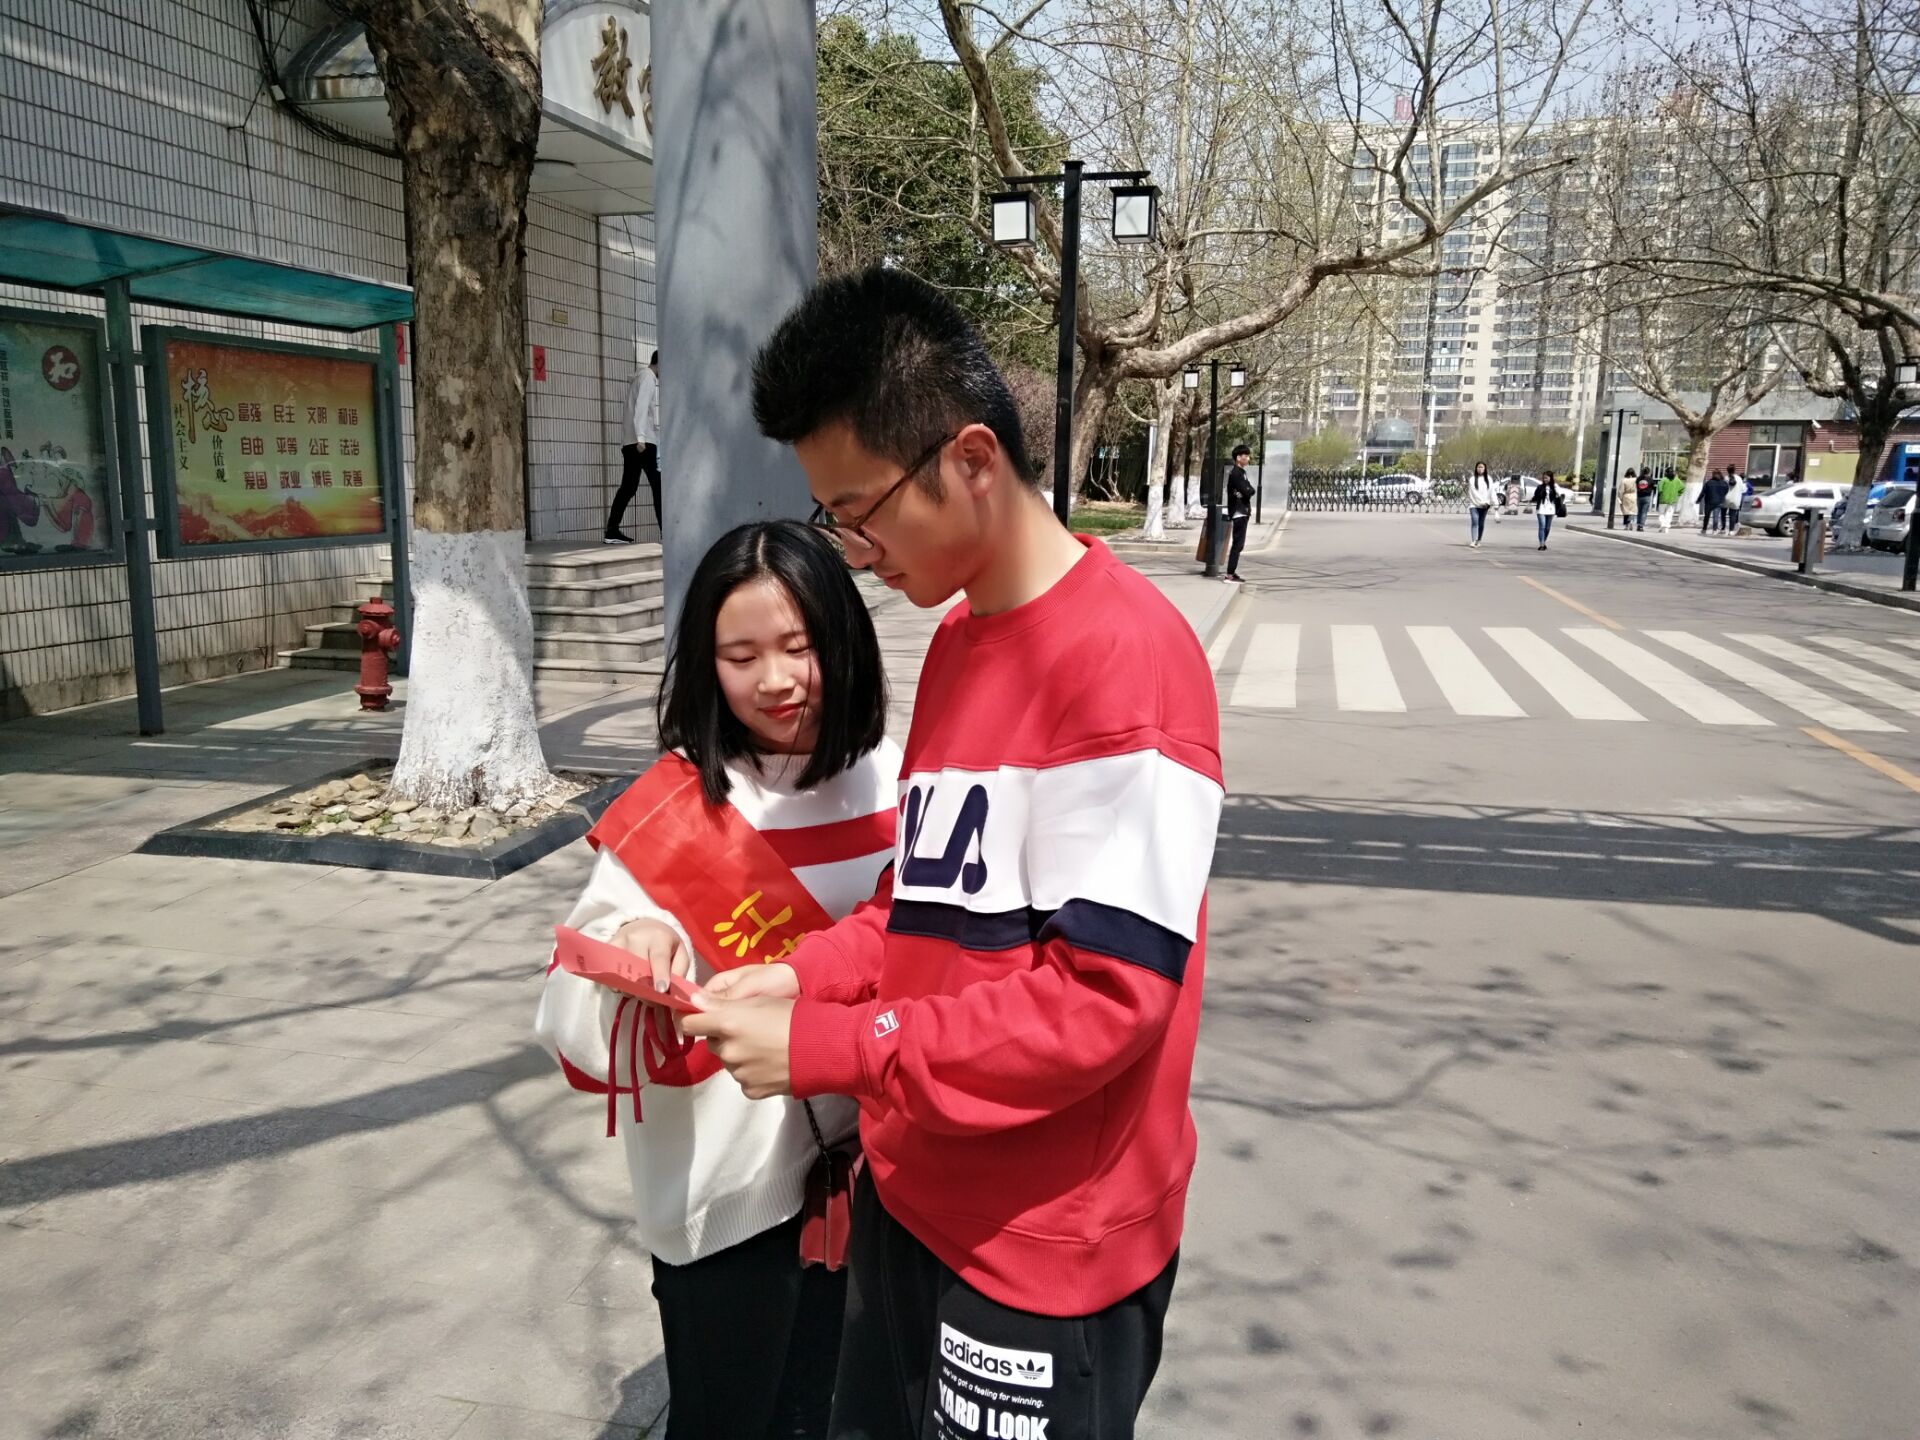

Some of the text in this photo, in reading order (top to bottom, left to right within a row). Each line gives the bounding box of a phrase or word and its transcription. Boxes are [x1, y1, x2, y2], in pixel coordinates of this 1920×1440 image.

[238, 403, 359, 425] 富强 民主 文明 和谐
[174, 403, 189, 470] 社会主义
[240, 436, 360, 456] 自由 平等 公正 法治
[212, 434, 227, 482] 价值观
[243, 470, 364, 490] 爱国 敬业 诚信 友善
[944, 1336, 1013, 1377] adidas
[938, 1377, 1049, 1440] YARD LOOK
[957, 1378, 968, 1388] got
[999, 1392, 1010, 1401] for
[1011, 1395, 1044, 1408] winning.
